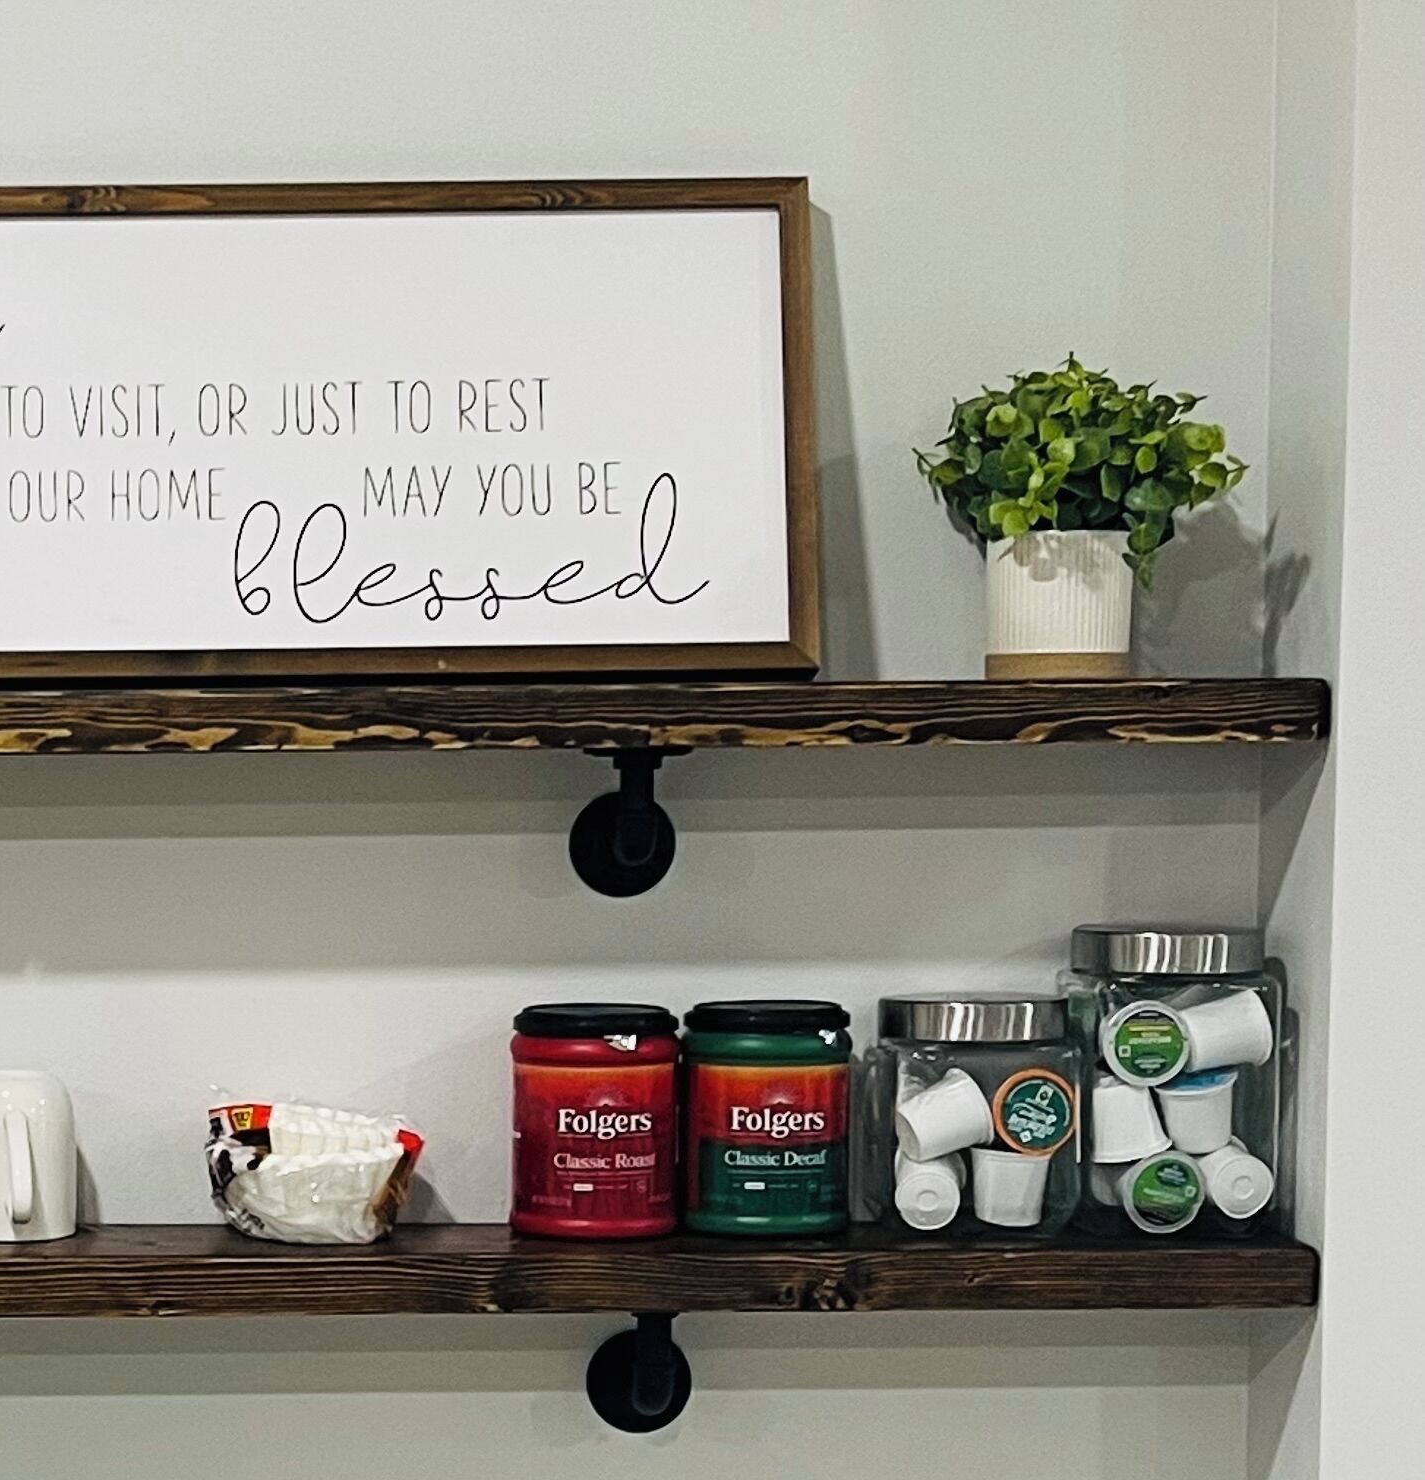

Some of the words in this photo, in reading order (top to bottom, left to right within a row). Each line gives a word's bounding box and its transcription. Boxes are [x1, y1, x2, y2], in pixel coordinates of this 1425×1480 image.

[4, 384, 45, 439] TO
[68, 383, 177, 448] VISIT,
[197, 382, 248, 438] OR
[270, 380, 363, 437] JUST
[386, 379, 432, 435] TO
[458, 376, 551, 433] REST
[8, 468, 86, 524] OUR
[111, 466, 227, 522] HOME
[362, 464, 453, 519] MAY
[475, 462, 552, 518] YOU
[577, 460, 623, 516] BE
[233, 471, 711, 623] blessed
[558, 1109, 652, 1139] Folgers
[731, 1107, 825, 1137] Folgers
[554, 1153, 610, 1169] Classic
[615, 1152, 655, 1169] Roast
[724, 1150, 780, 1166] Classic
[783, 1149, 827, 1165] Decaf
